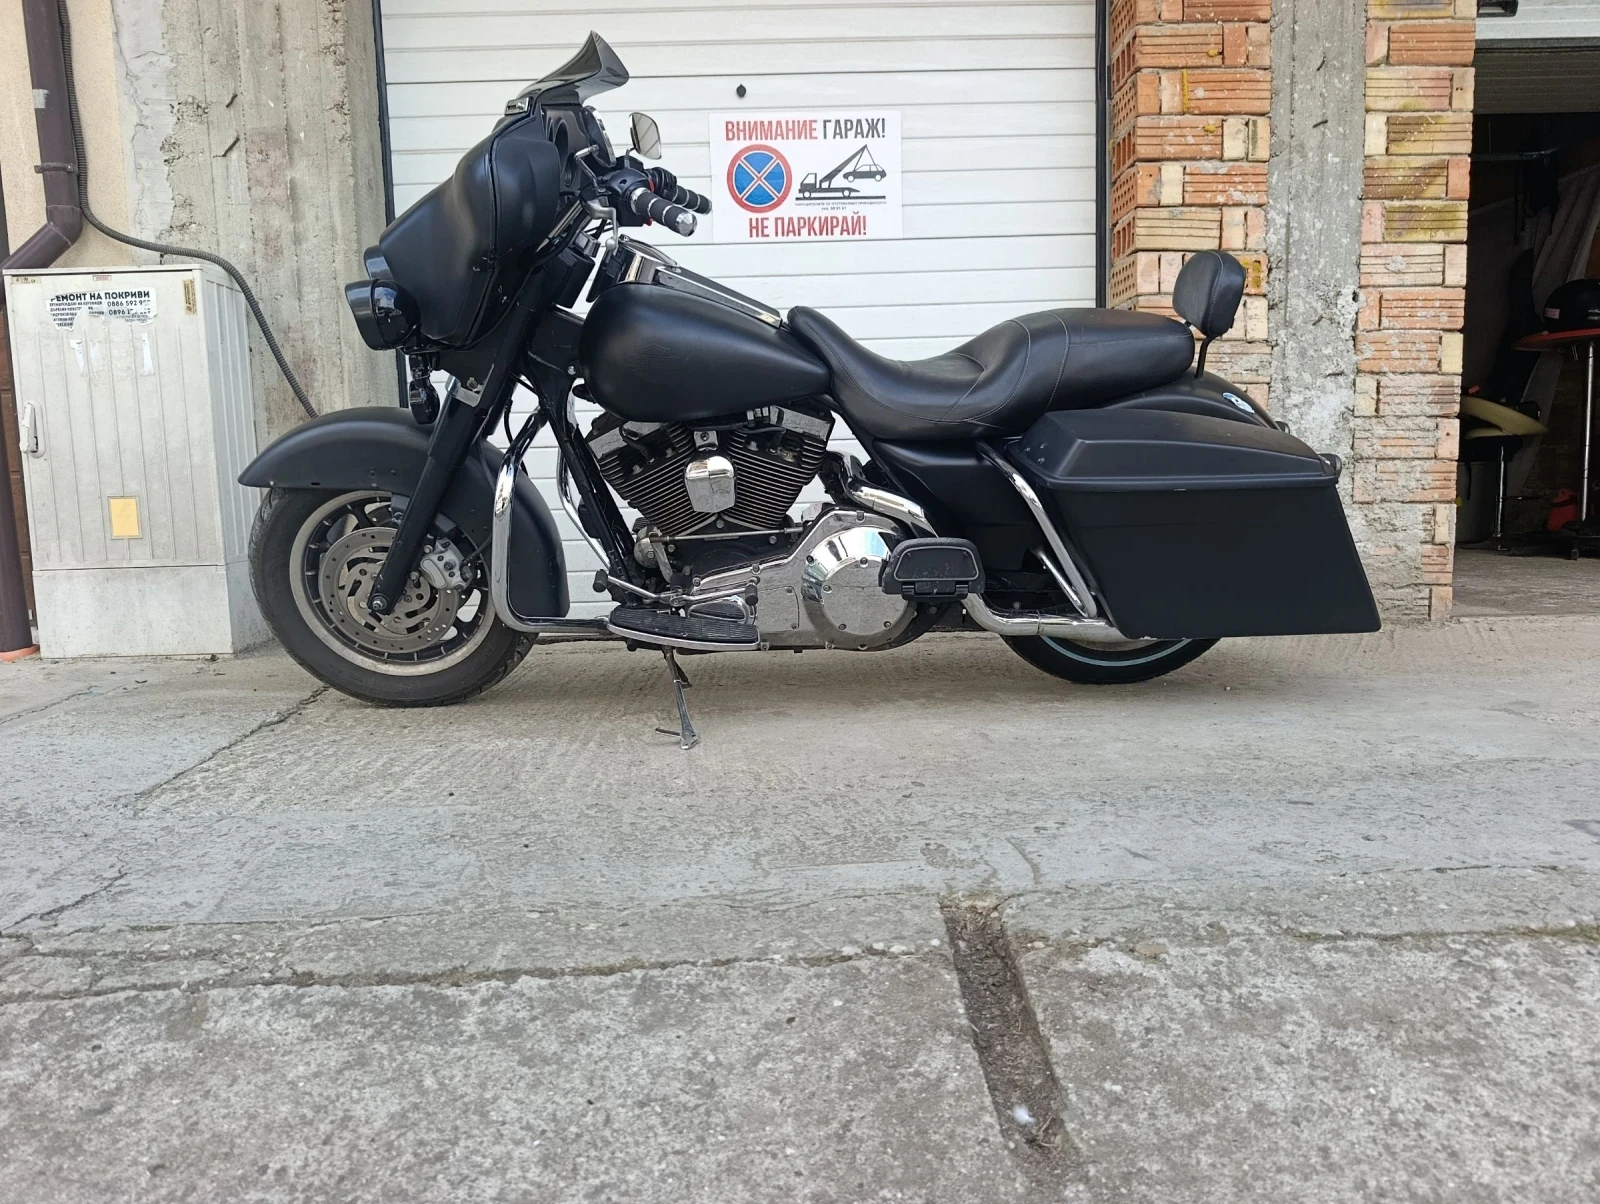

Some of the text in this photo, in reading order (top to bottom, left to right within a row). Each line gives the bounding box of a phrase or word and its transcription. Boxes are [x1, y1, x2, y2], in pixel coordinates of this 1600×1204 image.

[725, 118, 886, 141] ВНИМАНИЕ ГАРАЖ!
[749, 211, 867, 238] НЕ ПАРКИРАЙ!
[90, 292, 103, 301] НА
[105, 290, 150, 300] ПОКРИВИ
